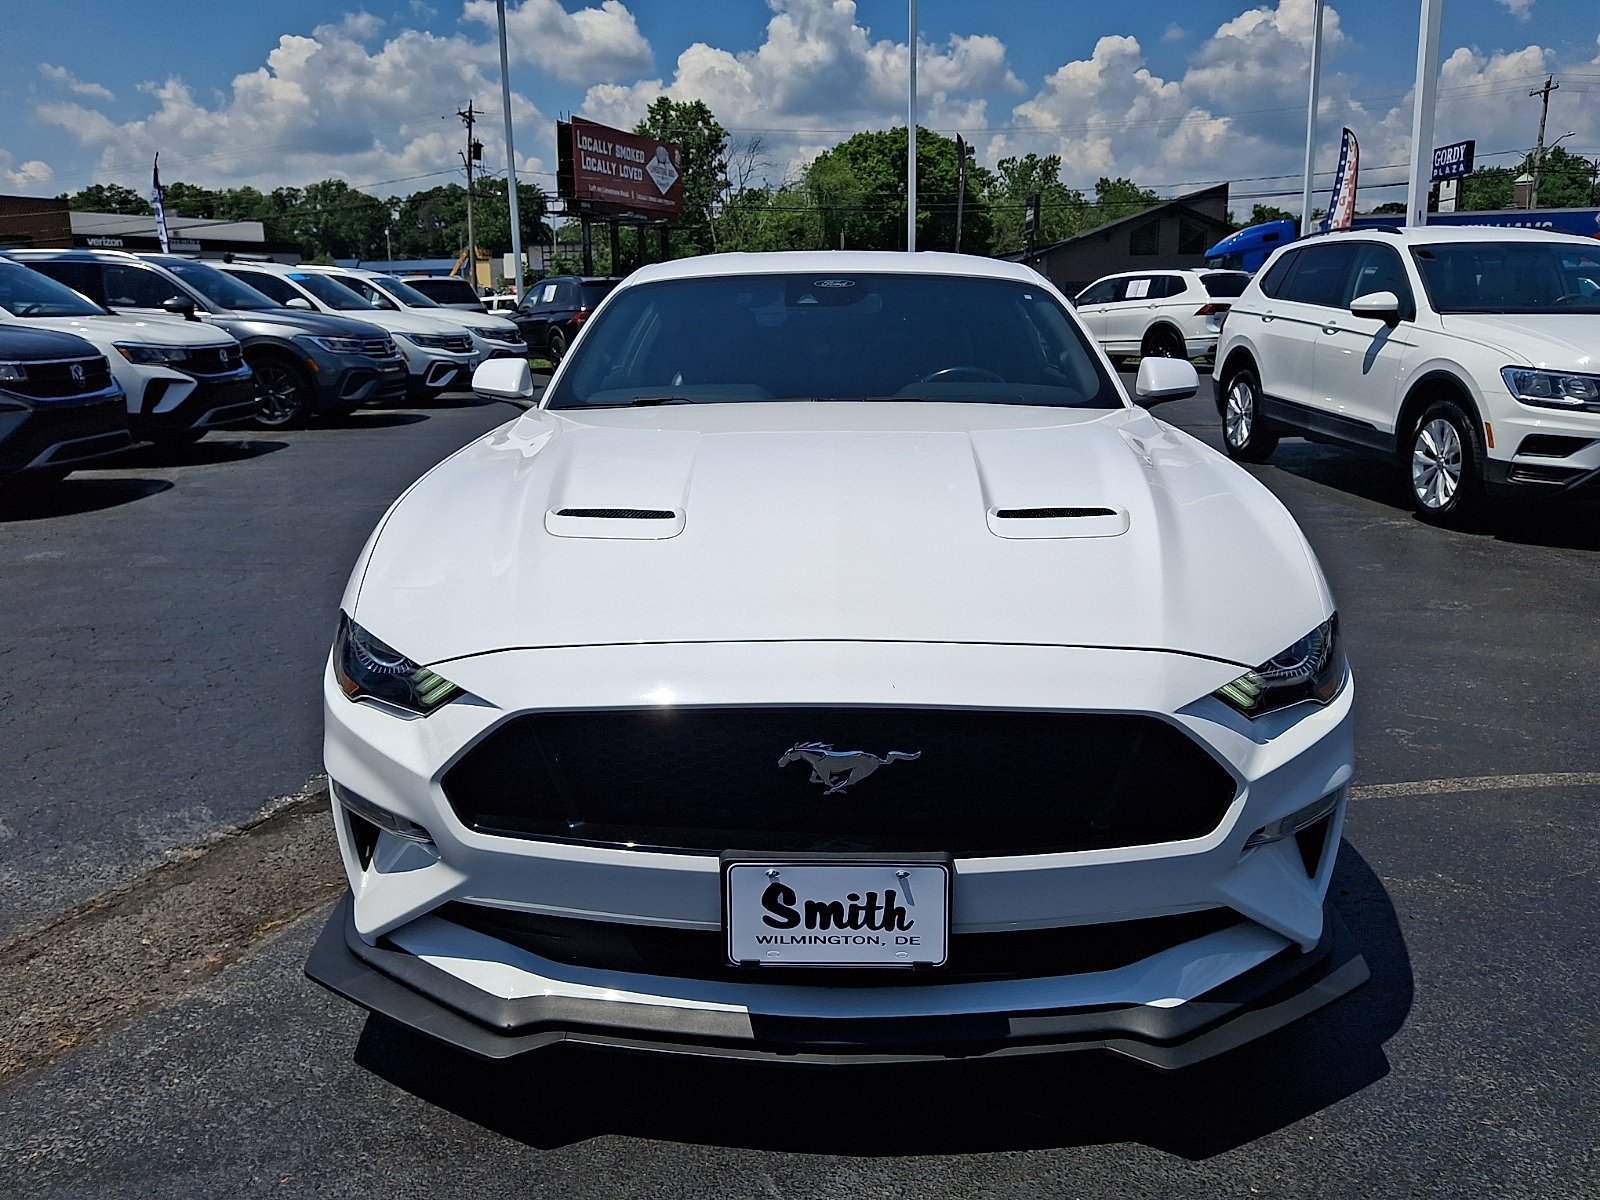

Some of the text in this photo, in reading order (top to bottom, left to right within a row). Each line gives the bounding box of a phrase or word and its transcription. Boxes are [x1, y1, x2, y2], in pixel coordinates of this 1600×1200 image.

[577, 130, 645, 163] LOCALLY SMOKED
[1434, 144, 1467, 167] GORDY
[581, 151, 617, 176] LOCALLY
[619, 164, 643, 181] LOVED
[1433, 163, 1465, 177] PLAZA
[87, 236, 123, 247] verizon
[761, 882, 915, 932] Smith
[755, 935, 921, 947] WILMINGTON, DE
